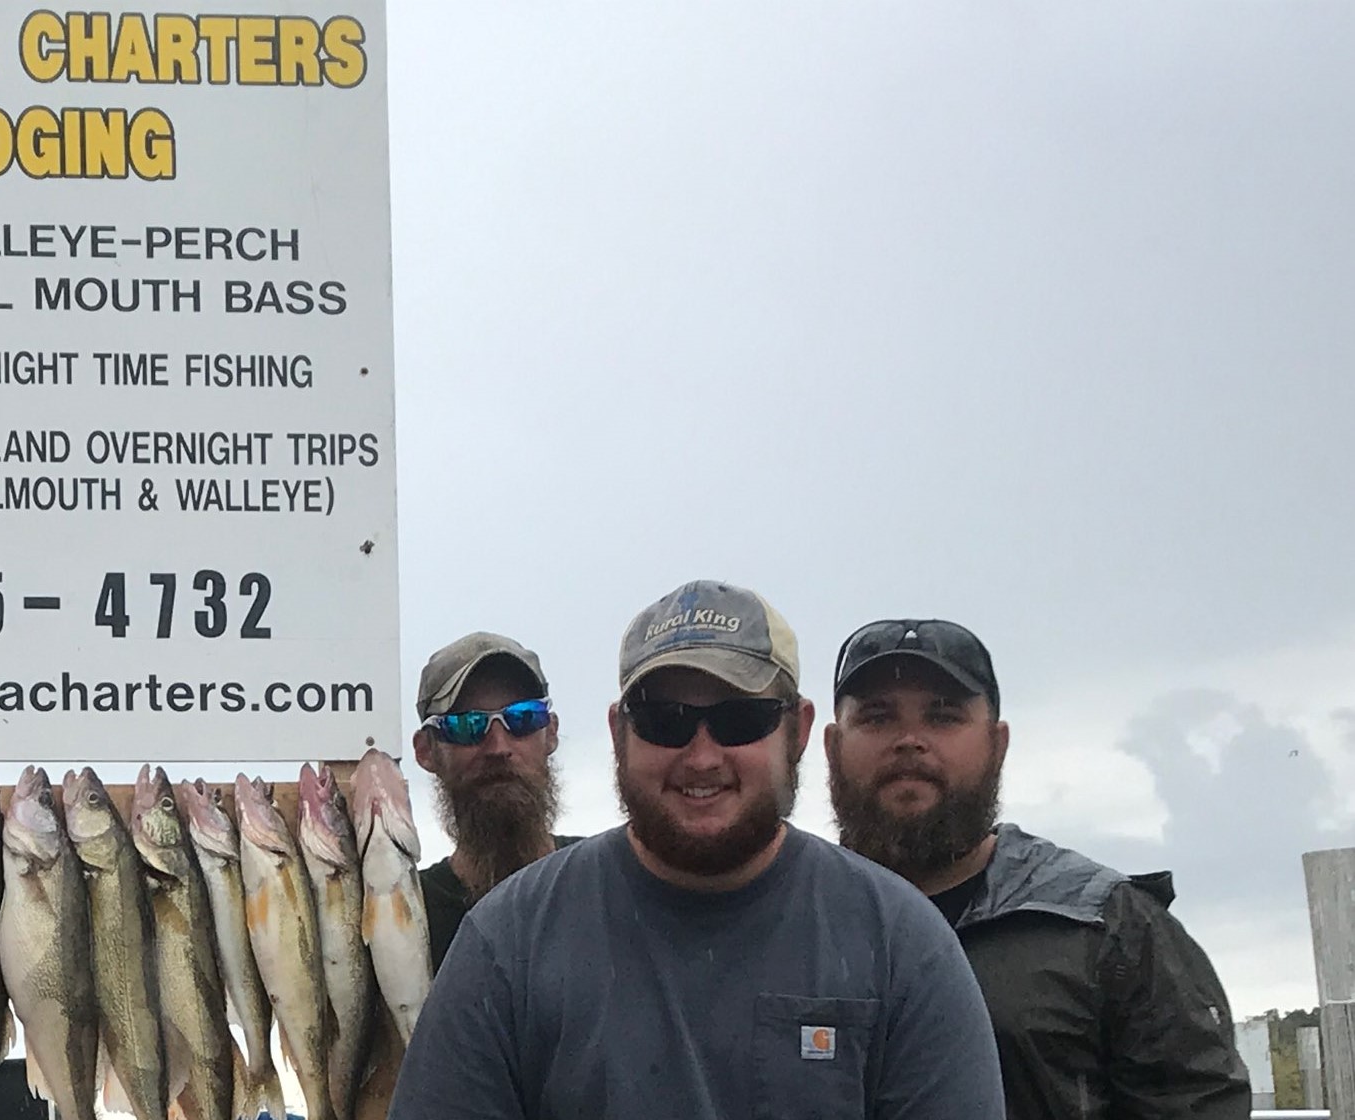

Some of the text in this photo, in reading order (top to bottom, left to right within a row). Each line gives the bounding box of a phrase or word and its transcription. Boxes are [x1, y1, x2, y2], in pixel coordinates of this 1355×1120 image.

[18, 10, 368, 89] CHARTERS
[35, 277, 201, 314] MOUTH
[224, 280, 347, 316] BASS
[92, 352, 169, 387] TIME
[185, 354, 313, 389] FISHING
[86, 430, 273, 467] OVERNIGHT
[286, 433, 379, 468] TRIPS
[138, 478, 159, 512] &
[175, 476, 335, 516] WALLEYE)
[644, 609, 692, 642] Rural
[692, 608, 742, 633] King
